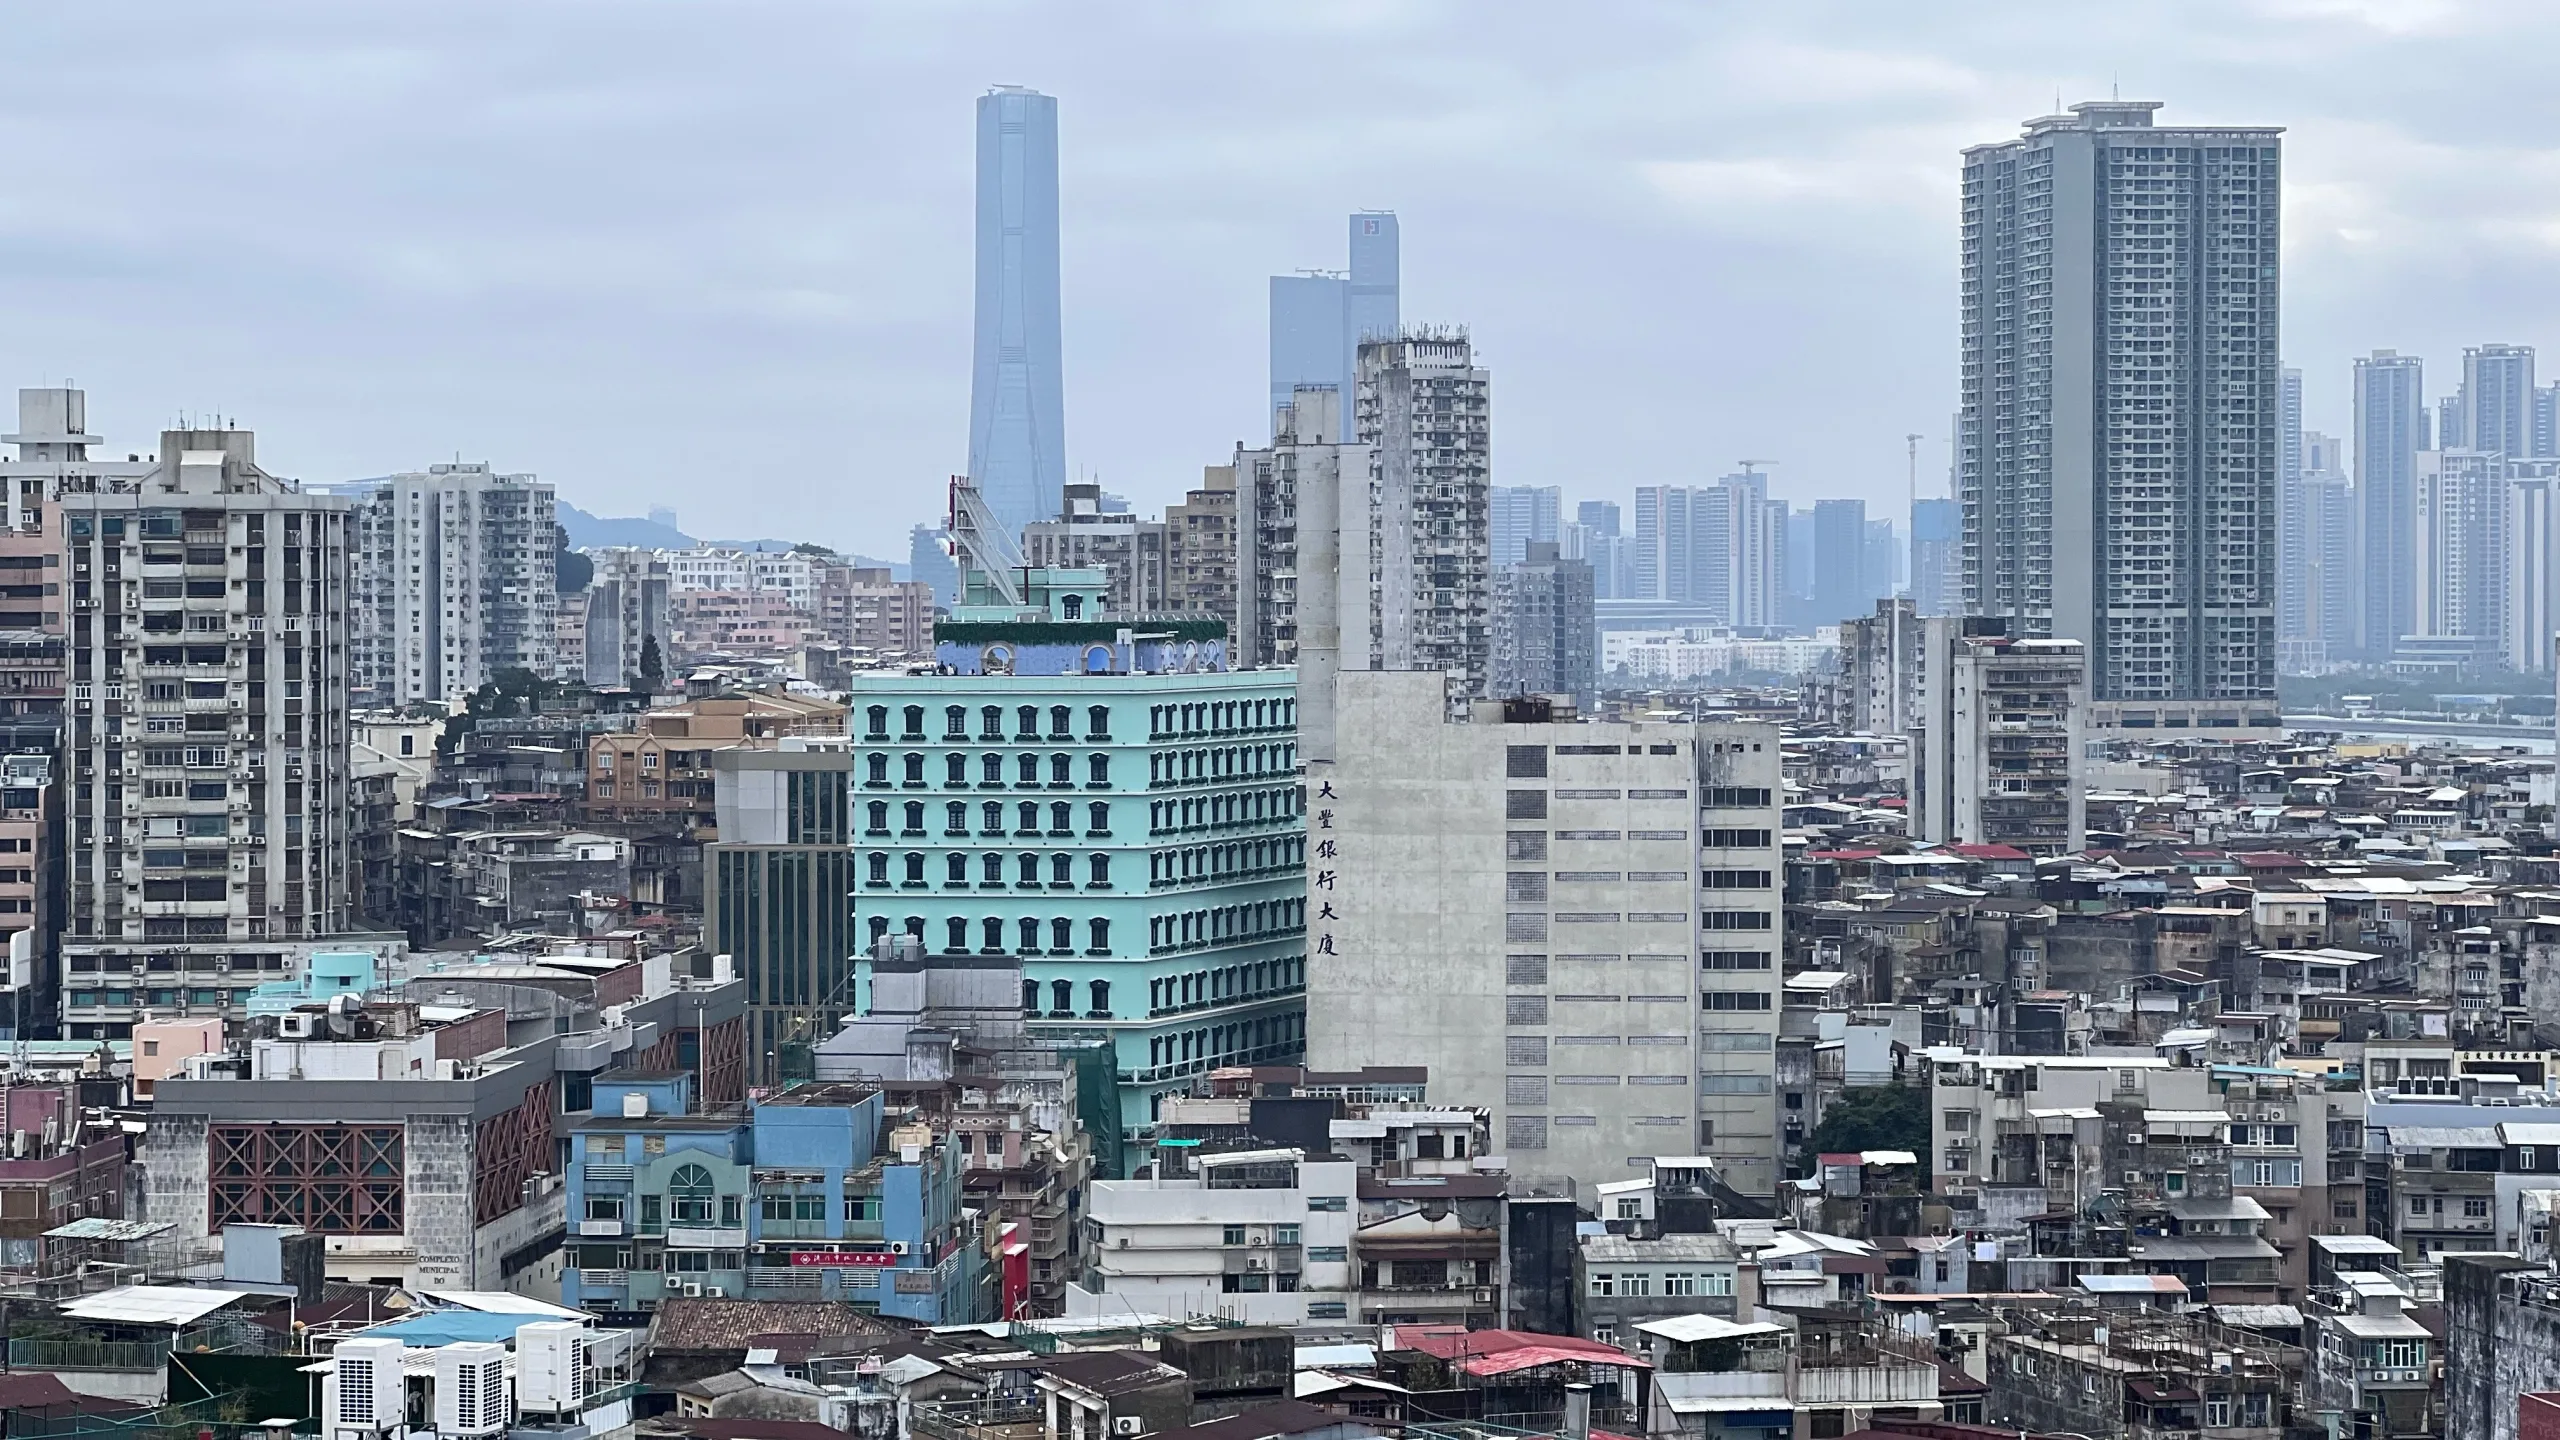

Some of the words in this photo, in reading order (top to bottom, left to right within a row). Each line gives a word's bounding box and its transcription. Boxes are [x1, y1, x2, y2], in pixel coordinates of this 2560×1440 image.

[1316, 780, 1339, 956] 大豐銀行大廈
[419, 1255, 460, 1263] COMPLEXO
[419, 1266, 460, 1274] MUNICIPAL
[434, 1277, 445, 1285] DO
